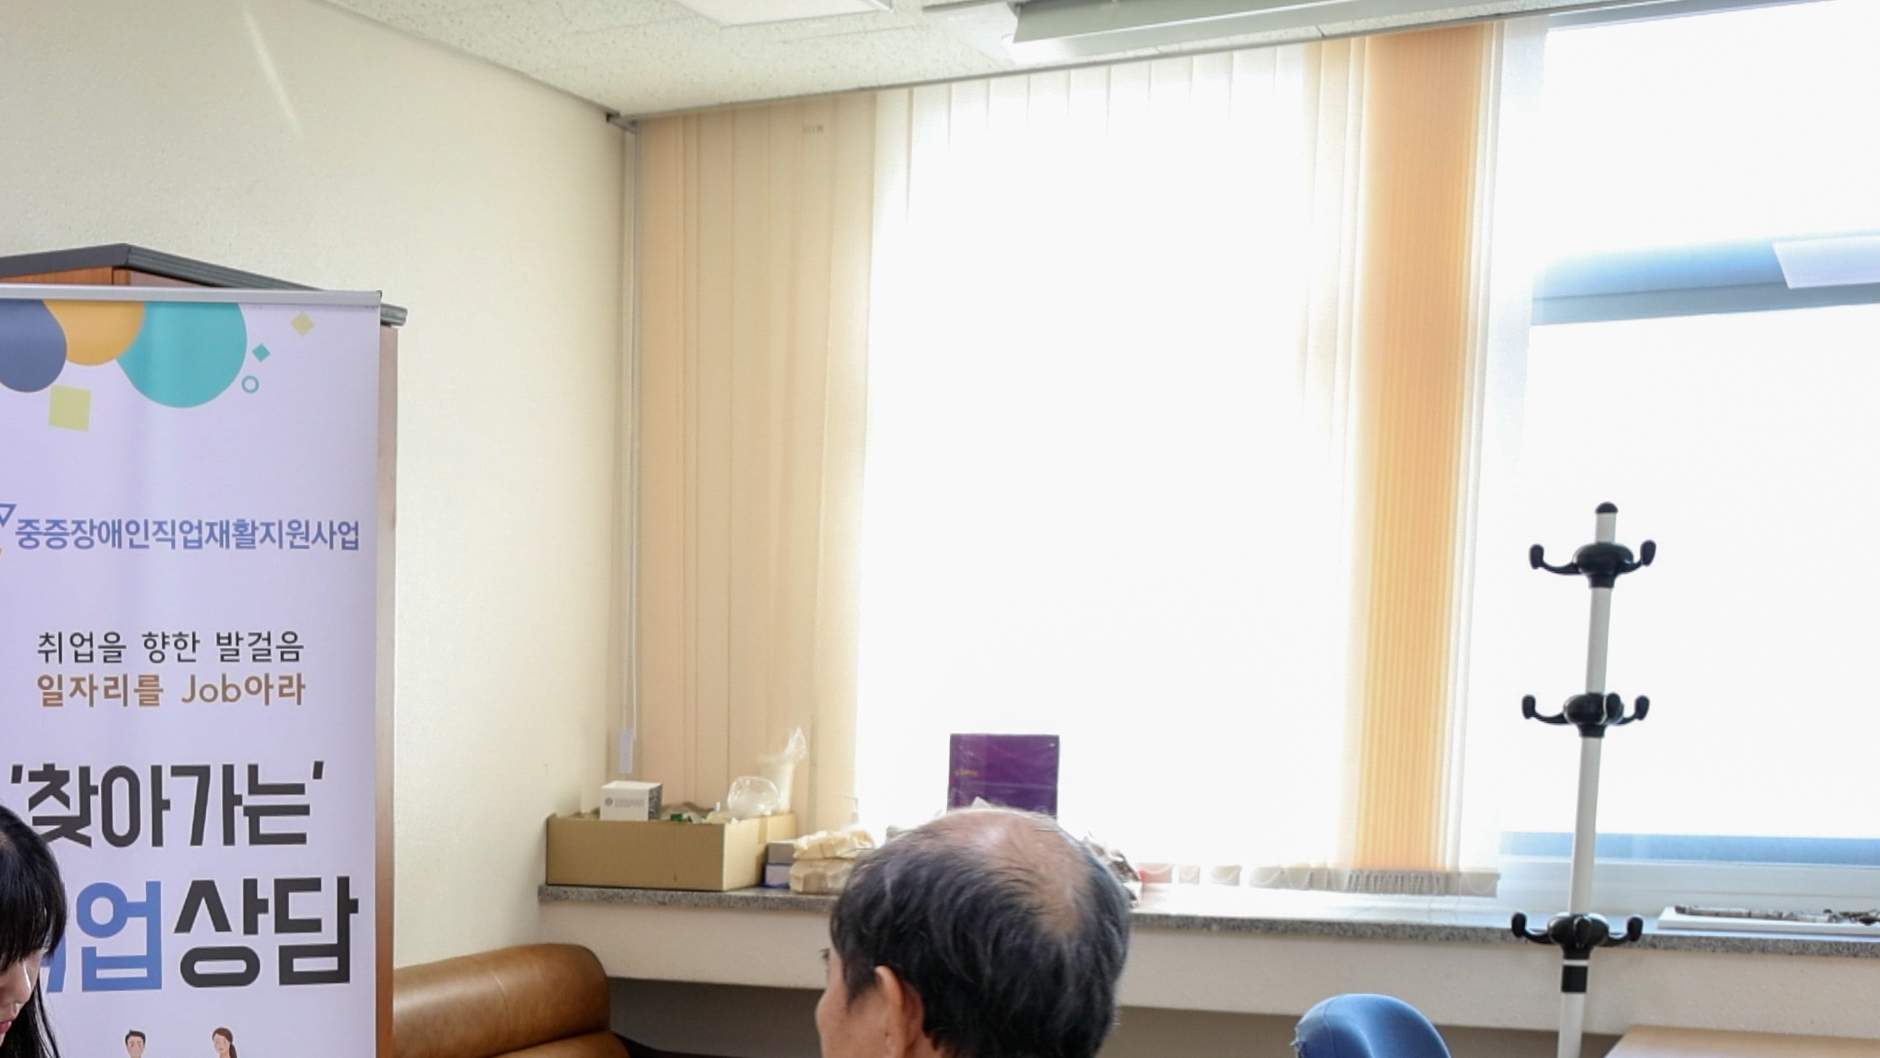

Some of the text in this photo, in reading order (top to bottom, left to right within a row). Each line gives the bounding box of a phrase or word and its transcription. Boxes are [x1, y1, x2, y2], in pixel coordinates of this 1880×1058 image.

[15, 518, 360, 550] 중증장애인직업재활지원사업
[37, 631, 305, 664] 취업을 향한 발걸음
[37, 672, 307, 707] 일자리를 Job아라
